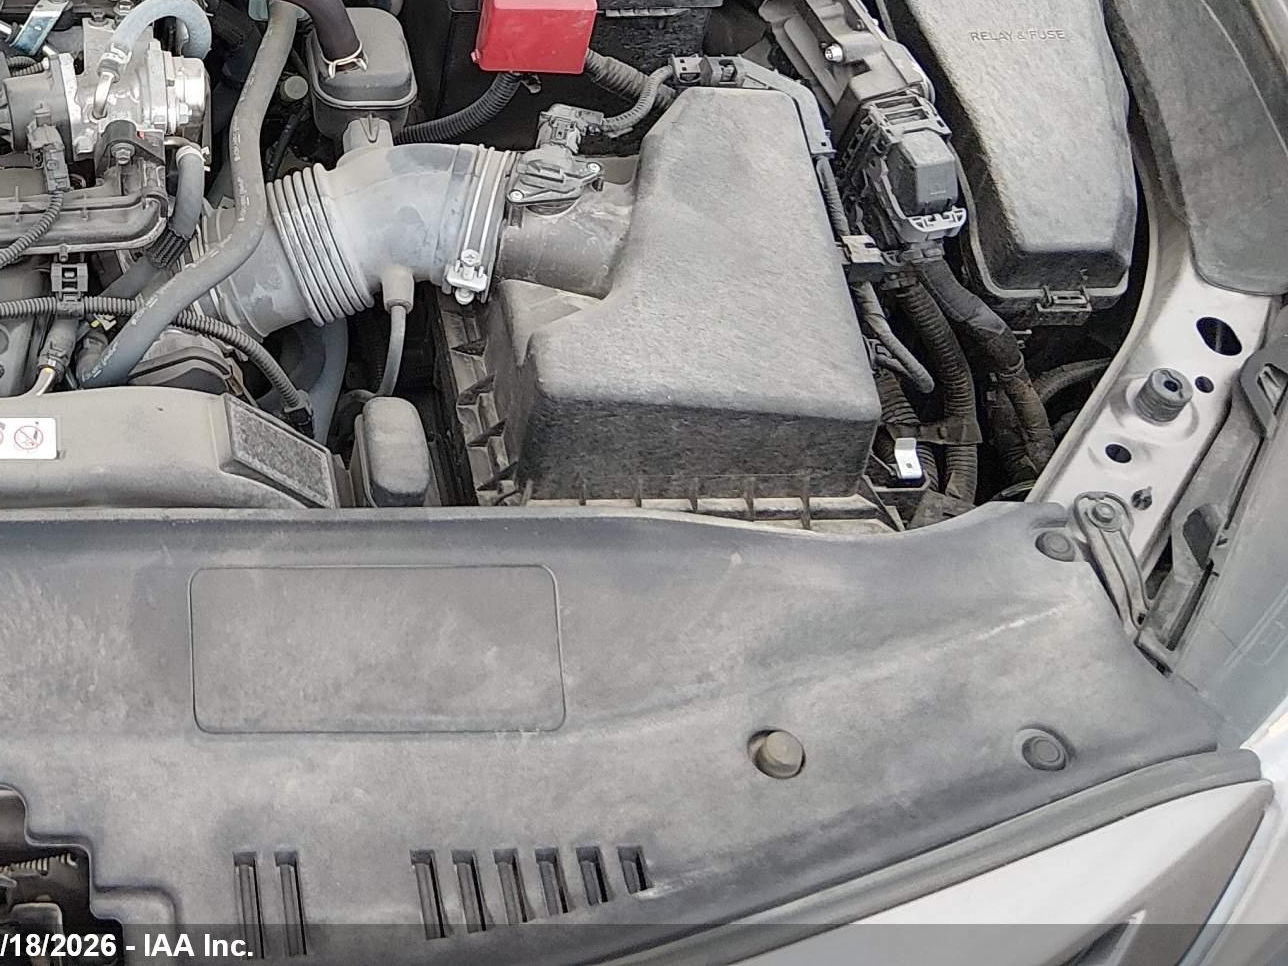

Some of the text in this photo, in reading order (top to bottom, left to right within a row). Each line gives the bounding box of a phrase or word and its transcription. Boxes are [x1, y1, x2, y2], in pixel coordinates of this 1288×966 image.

[971, 29, 1064, 41] RELAY & FUSE
